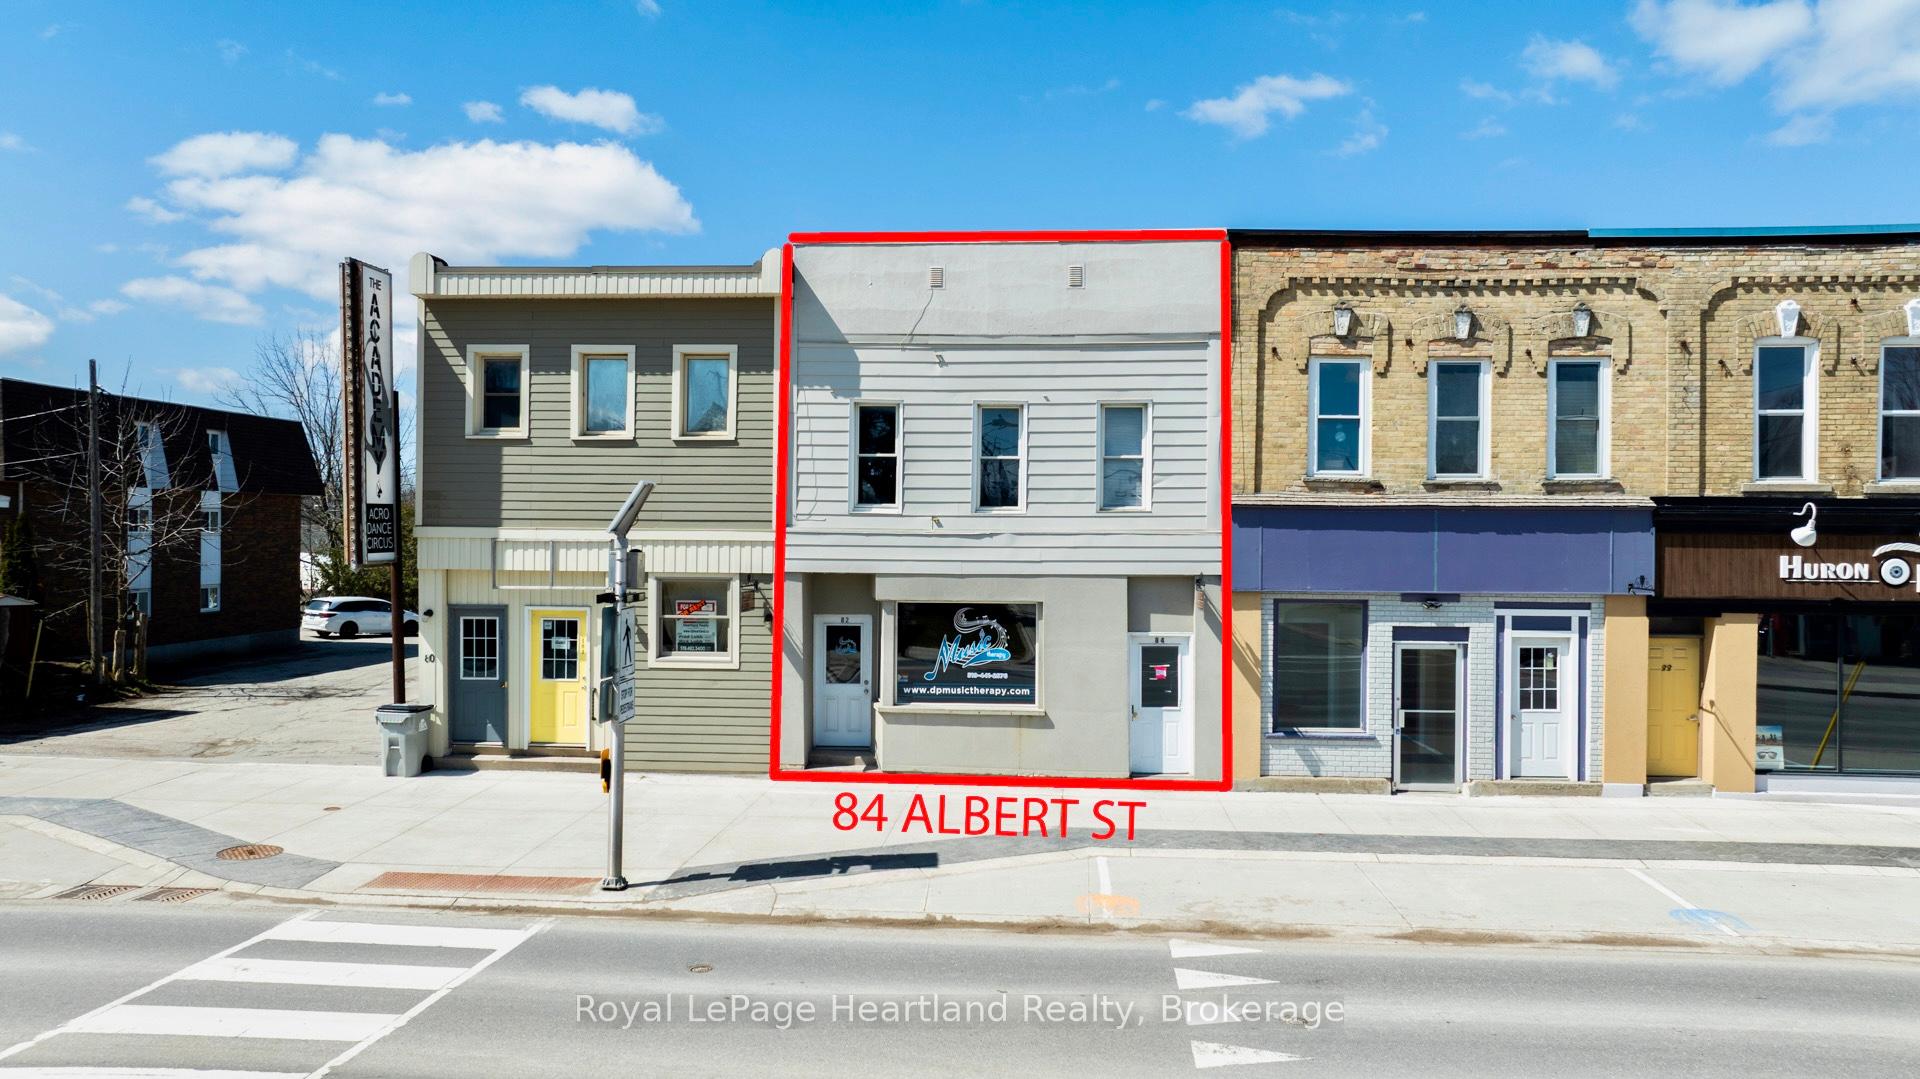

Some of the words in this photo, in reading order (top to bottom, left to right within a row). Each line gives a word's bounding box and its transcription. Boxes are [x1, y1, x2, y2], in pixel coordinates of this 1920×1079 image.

[369, 277, 381, 291] THE
[369, 293, 386, 475] ACADEMY
[369, 508, 390, 520] ACRO
[367, 523, 392, 535] DANCE
[367, 537, 394, 550] CIRCUS
[924, 634, 992, 680] Music
[986, 650, 1007, 660] therapy
[903, 685, 1030, 696] www.dpmusictherapy.com
